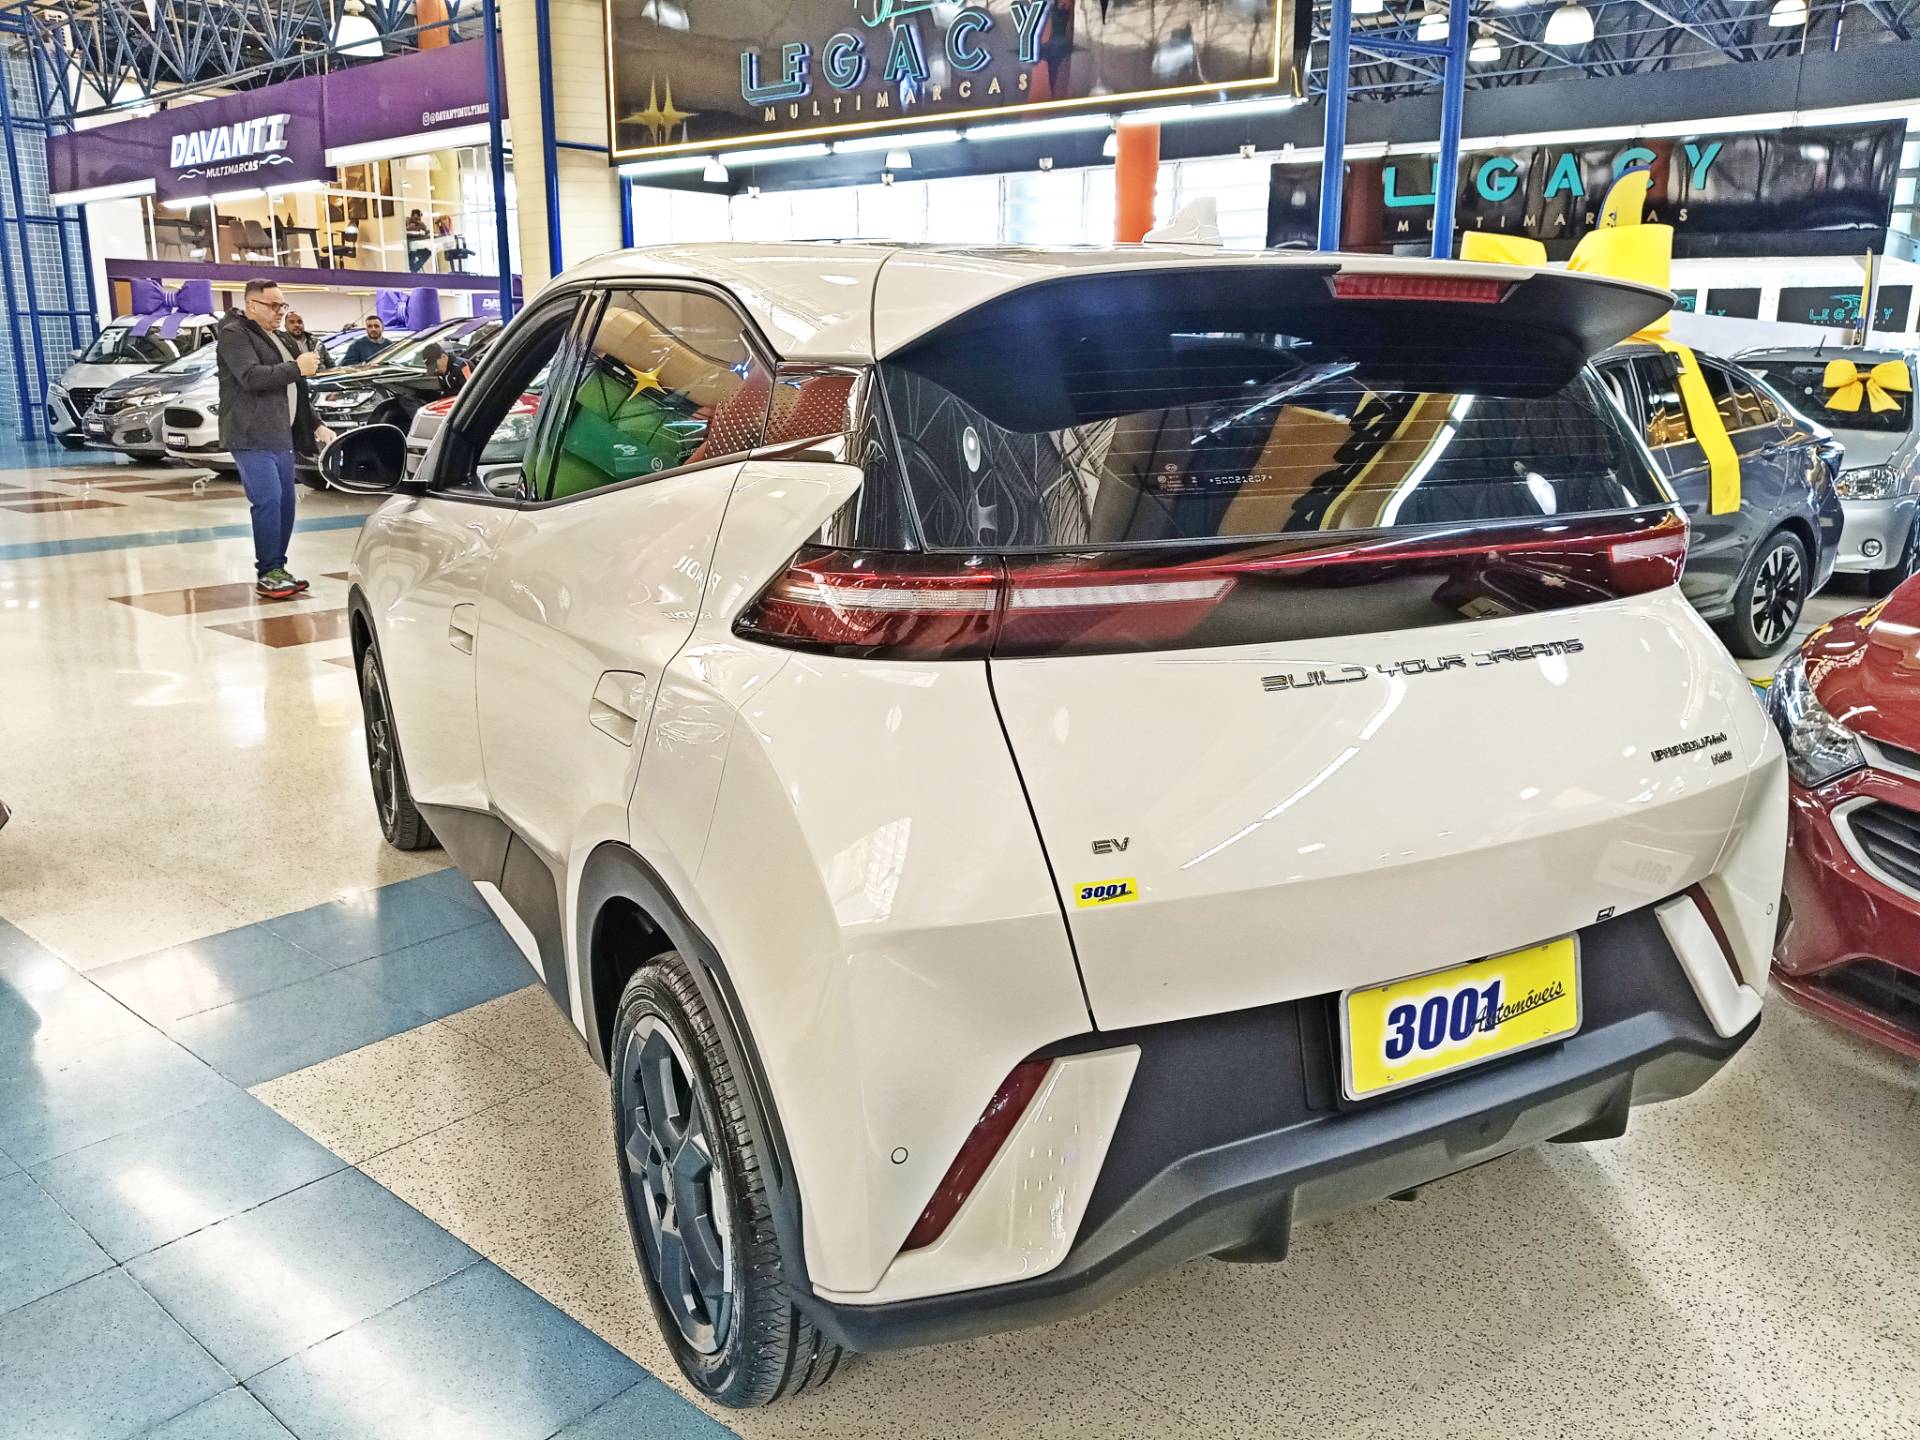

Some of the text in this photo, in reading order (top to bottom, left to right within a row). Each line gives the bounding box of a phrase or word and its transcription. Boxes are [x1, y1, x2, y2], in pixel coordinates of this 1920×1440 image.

[740, 0, 1049, 105] LEGACY
[764, 73, 1029, 122] MULTIMARCAS
[170, 114, 291, 168] DAVANTI
[206, 160, 259, 178] MULTIMARCAS
[1383, 143, 1722, 208] LGACY
[1397, 209, 1689, 232] MULTIMARAS
[1261, 638, 1585, 692] BUILD YOUR DREAMS
[1091, 836, 1130, 855] EV
[1081, 882, 1128, 900] 3001
[1385, 979, 1501, 1060] 3001
[1468, 979, 1566, 1034] Automóveis
